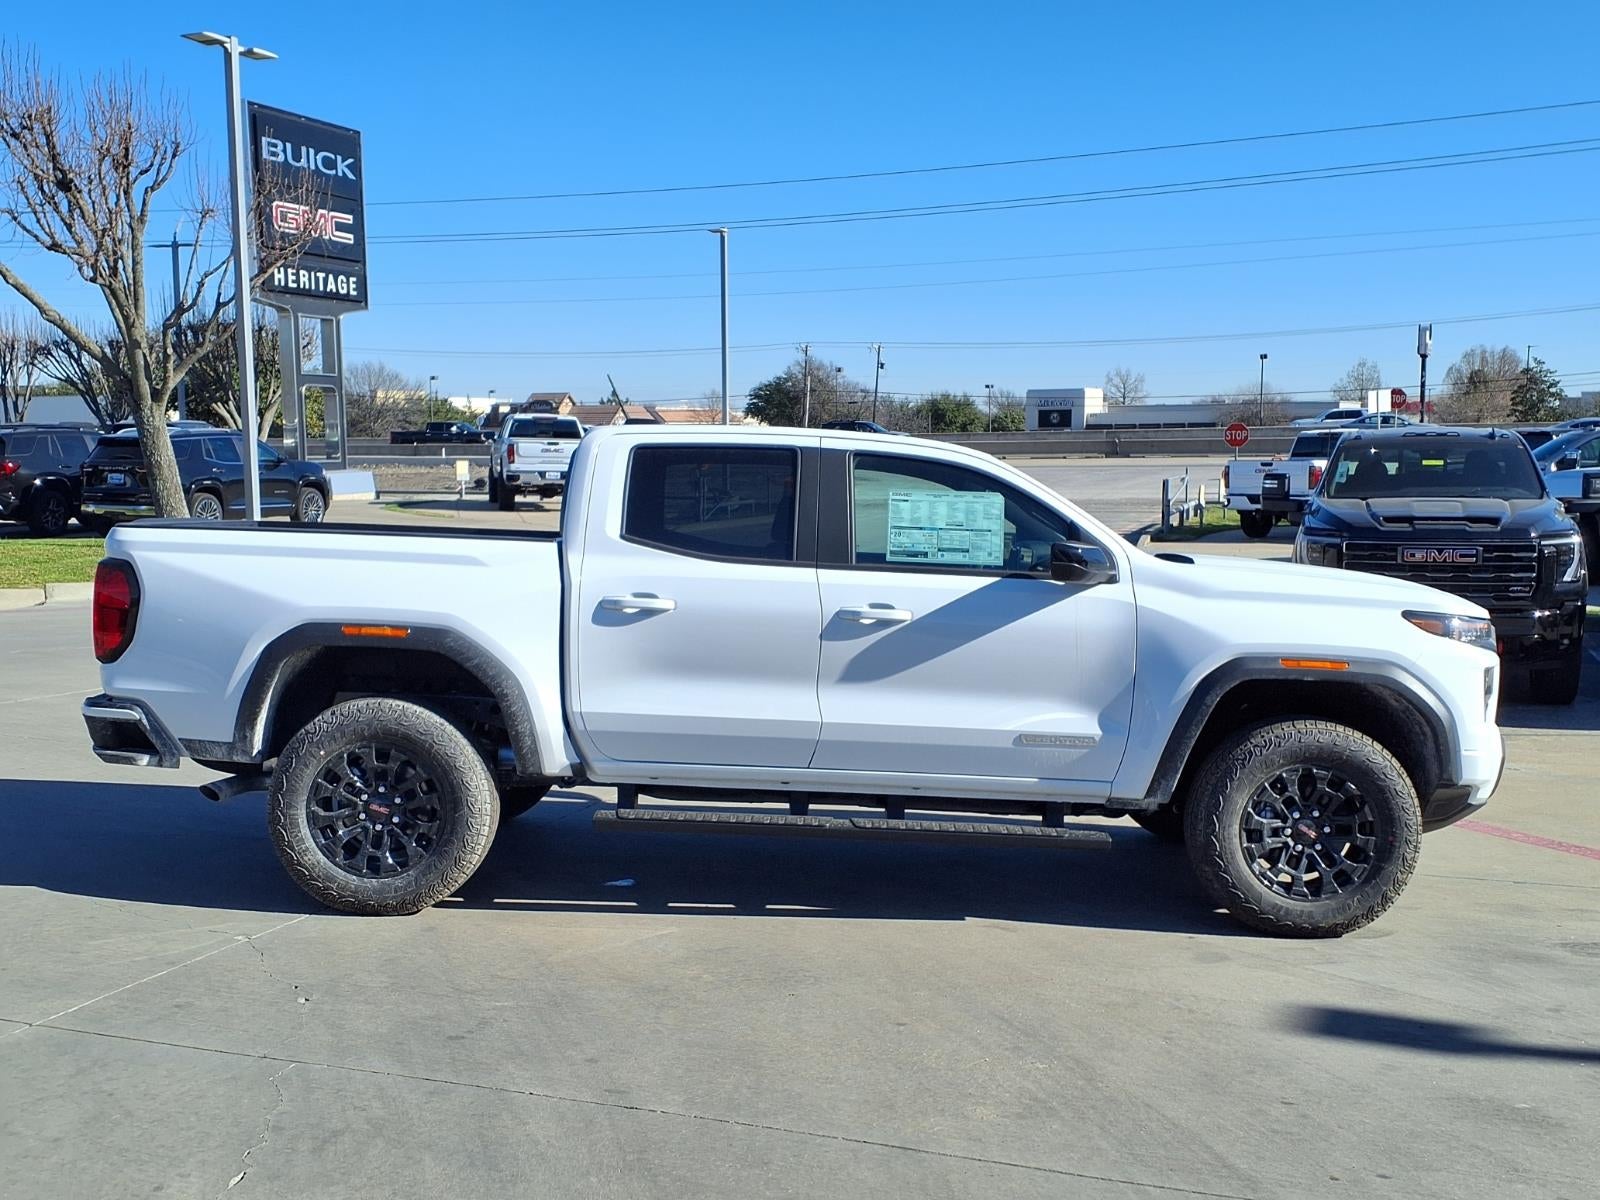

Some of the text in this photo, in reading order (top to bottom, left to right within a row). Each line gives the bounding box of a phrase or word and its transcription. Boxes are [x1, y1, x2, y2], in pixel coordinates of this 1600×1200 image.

[261, 136, 356, 180] BUICK
[272, 200, 354, 245] GMC
[273, 266, 358, 296] HERITAGE
[1391, 394, 1406, 403] TOP
[1225, 430, 1248, 440] STOP
[1404, 549, 1477, 563] GMC
